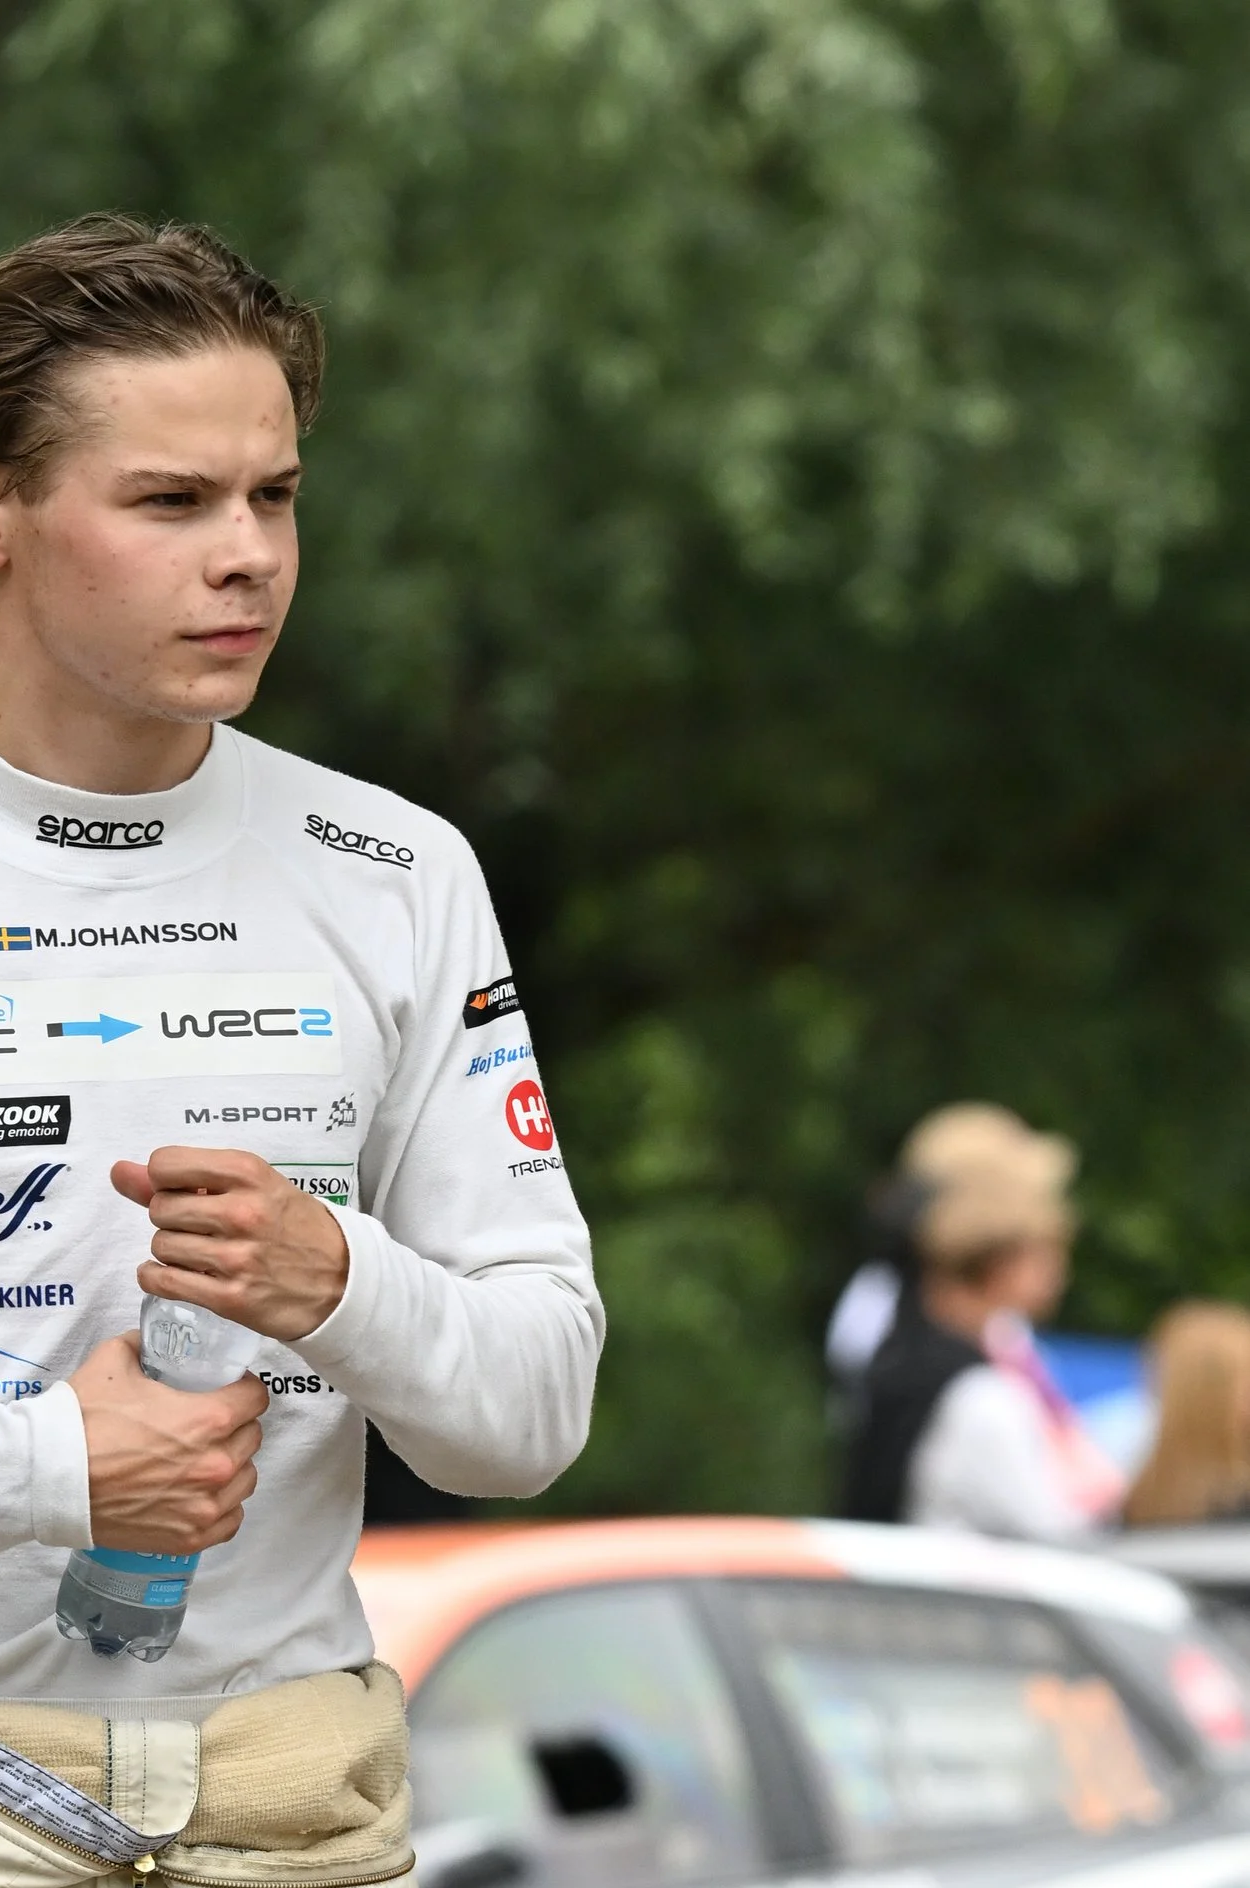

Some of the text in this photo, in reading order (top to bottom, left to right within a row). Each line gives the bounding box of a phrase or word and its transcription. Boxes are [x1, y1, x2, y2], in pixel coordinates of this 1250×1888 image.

[36, 814, 164, 849] sparco
[305, 814, 414, 868] sparco
[35, 922, 238, 947] M.JOHANSSON
[185, 1107, 317, 1123] M-SPORT
[7, 1125, 59, 1138] emotion
[259, 1372, 321, 1394] Forss
